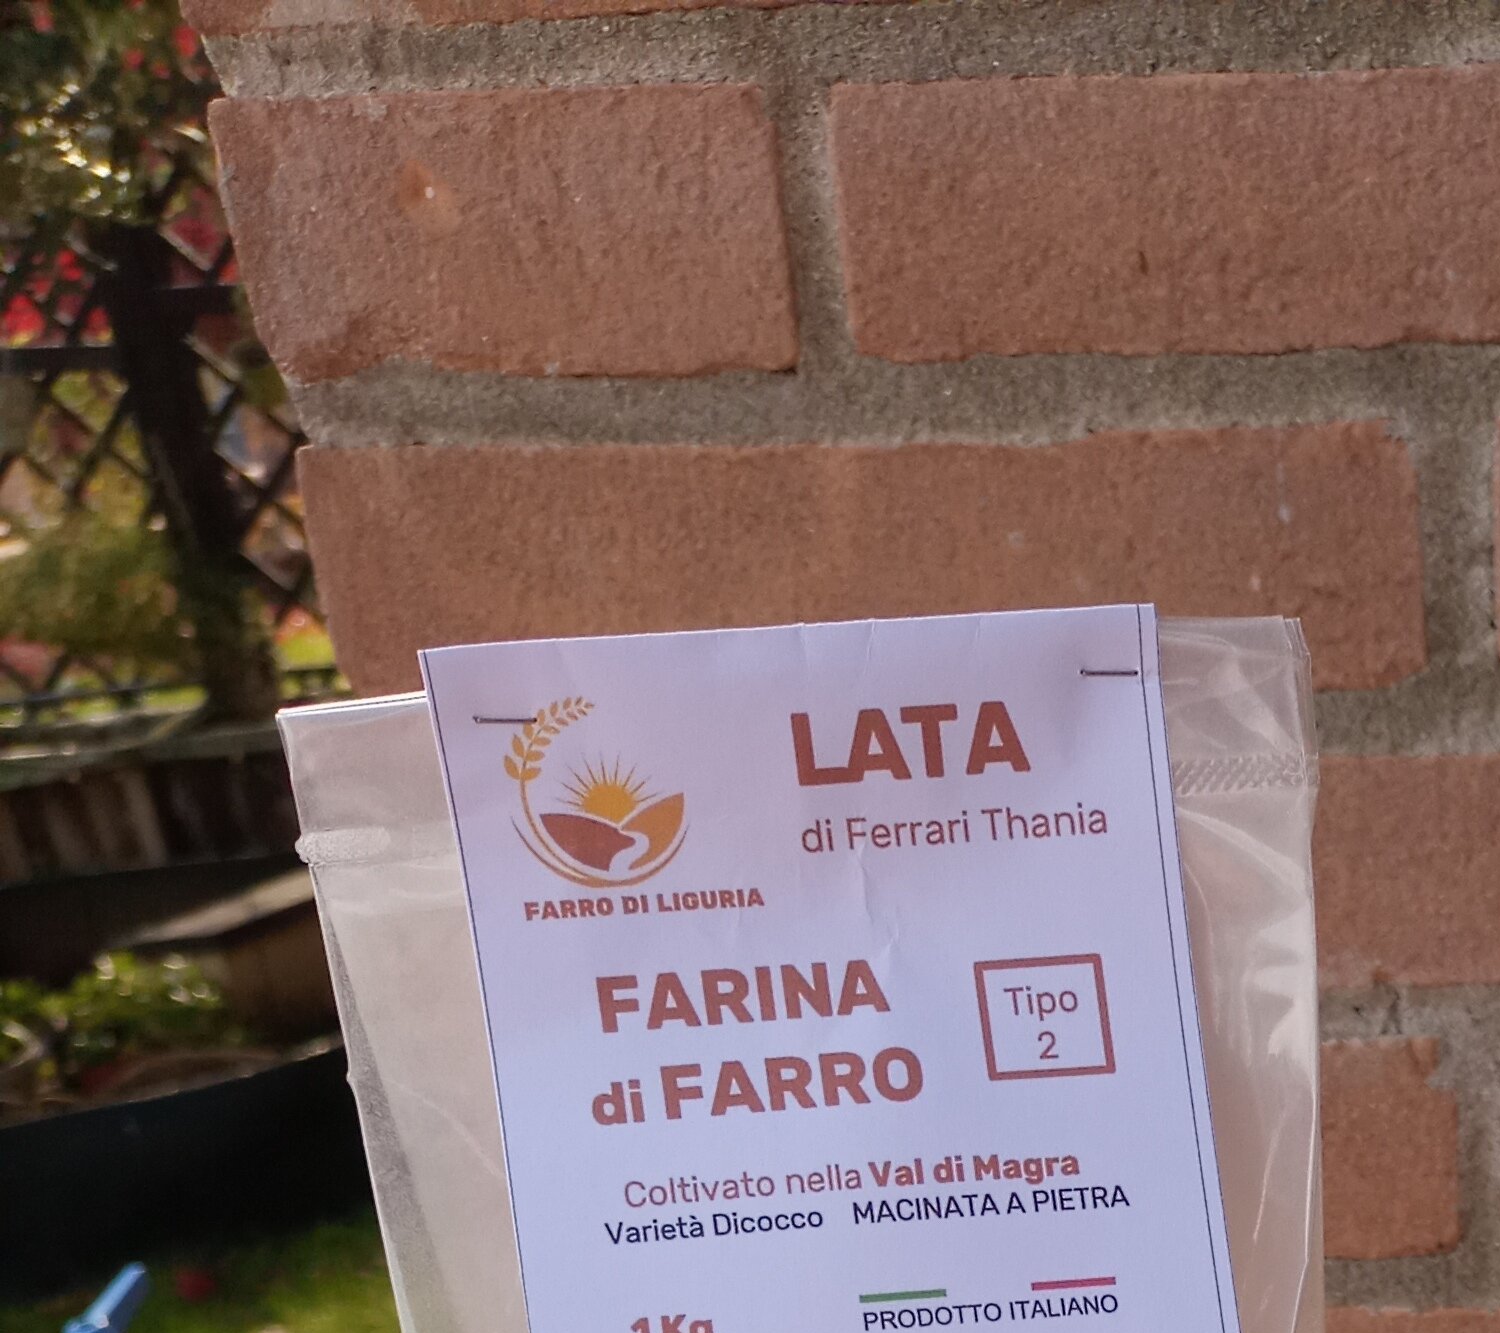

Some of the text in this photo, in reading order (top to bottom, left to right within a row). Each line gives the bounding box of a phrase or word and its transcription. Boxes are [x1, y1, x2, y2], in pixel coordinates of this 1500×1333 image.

[790, 700, 1032, 787] LATA
[801, 801, 1108, 854] di Ferrari Thania
[523, 887, 766, 922] FARRO DI LIGURIA
[595, 958, 892, 1034] FARINA
[1002, 985, 1079, 1022] Tipo
[1037, 1030, 1060, 1060] 2
[591, 1046, 924, 1126] di FARRO
[624, 1153, 1081, 1208] Coltivato nella Val di Magra
[852, 1184, 1131, 1225] MACINATA A PIETRA
[604, 1211, 824, 1245] Varietà Dicocco
[862, 1293, 1119, 1332] PRODOTTO ITALIANO
